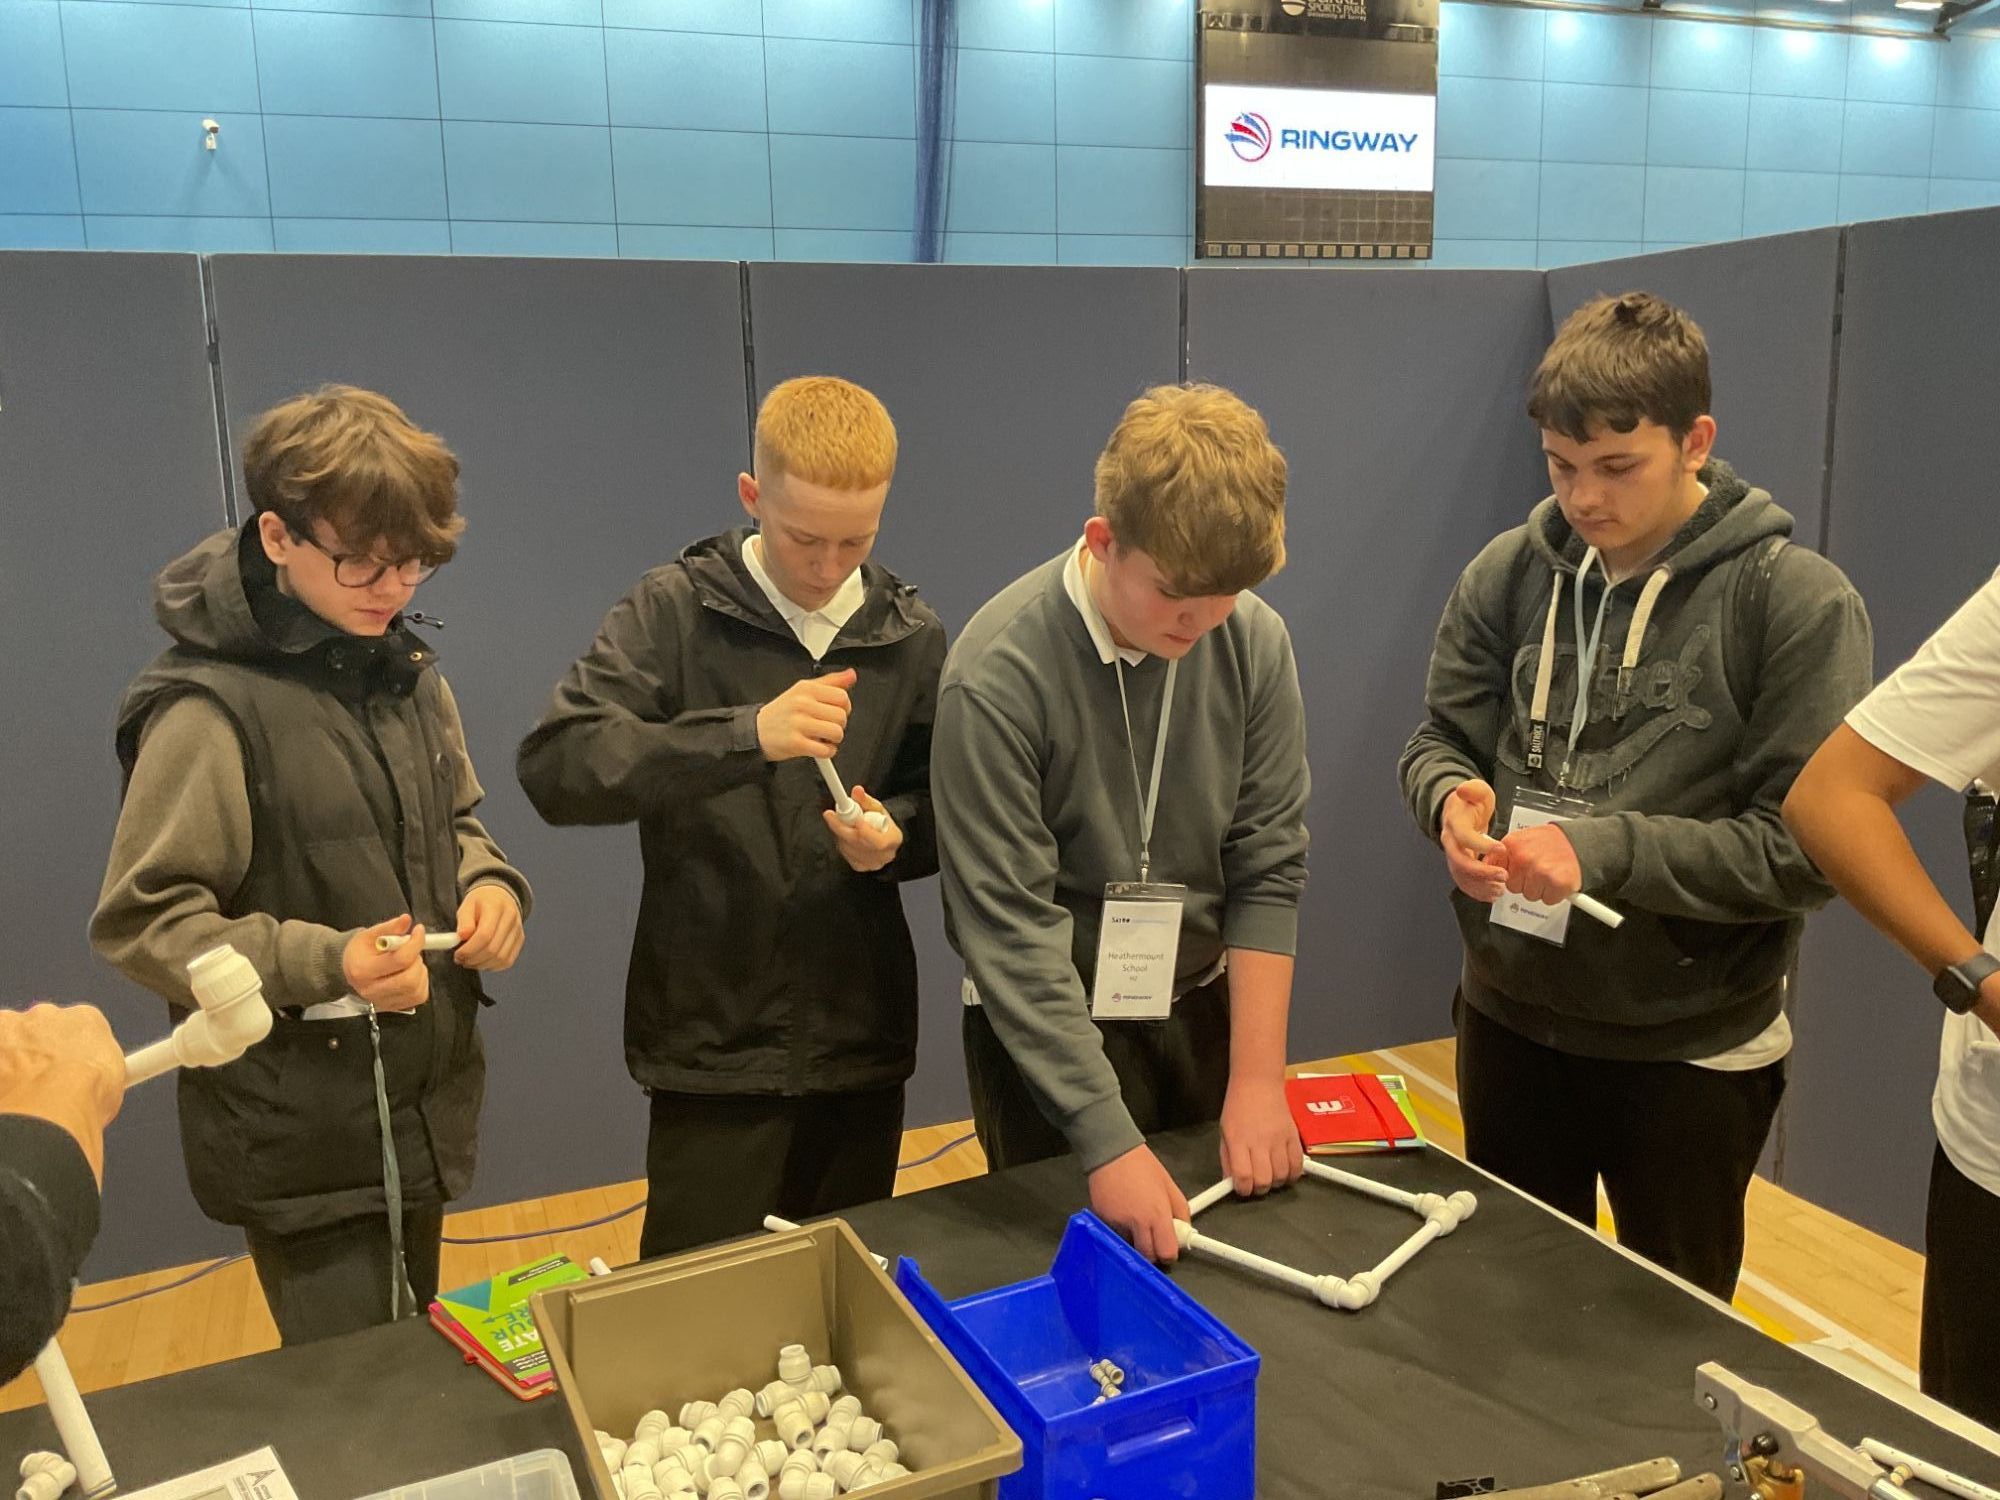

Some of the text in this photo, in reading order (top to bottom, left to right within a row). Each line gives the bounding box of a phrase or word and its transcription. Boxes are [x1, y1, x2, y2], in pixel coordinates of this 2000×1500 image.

[1307, 2, 1342, 13] SPORTS
[1343, 4, 1367, 15] PARK
[1280, 128, 1418, 152] RINGWAY
[1122, 964, 1148, 972] School
